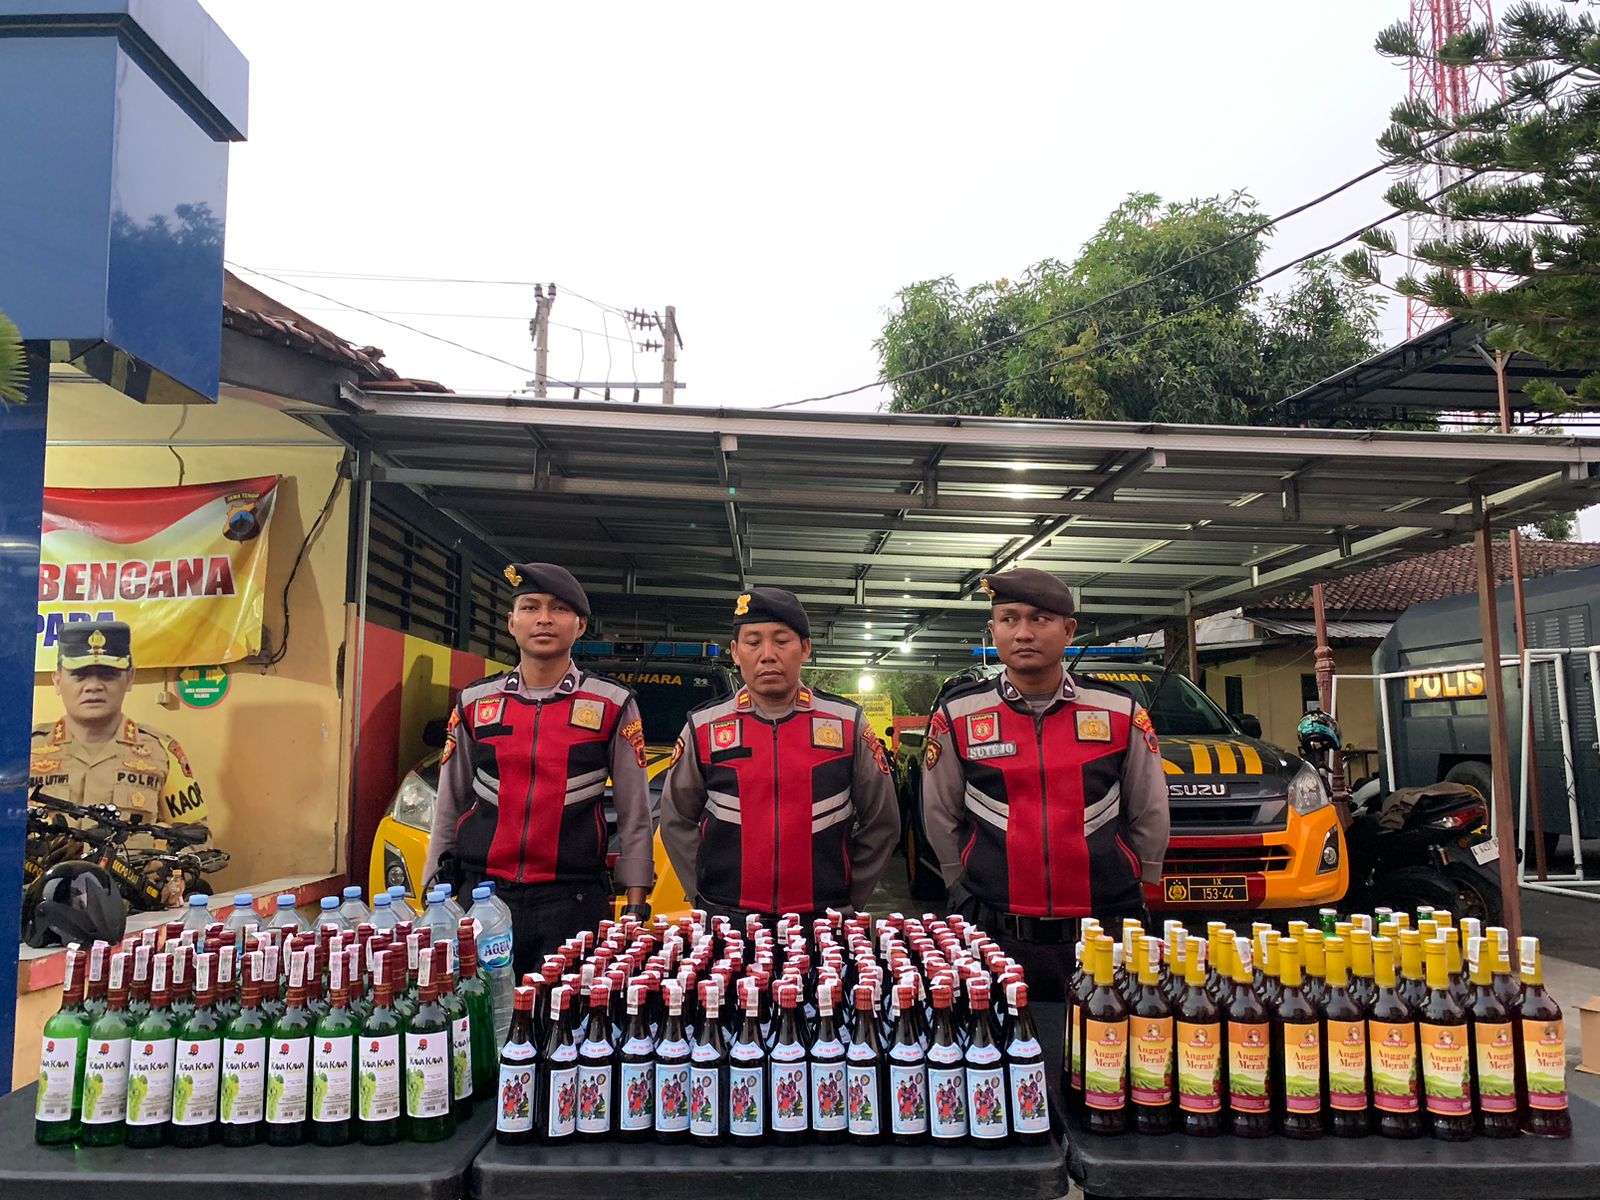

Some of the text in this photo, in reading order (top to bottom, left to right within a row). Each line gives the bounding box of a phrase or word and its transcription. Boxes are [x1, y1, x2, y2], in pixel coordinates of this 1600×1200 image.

[38, 557, 235, 601] BENCANA
[1408, 670, 1485, 699] POLIS
[117, 772, 159, 788] POLRI
[1202, 887, 1234, 900] 153-44
[484, 940, 510, 957] AQUA
[1093, 1049, 1122, 1059] Anggur
[1137, 1044, 1167, 1055] Anggur
[1378, 1049, 1410, 1060] Anggur
[1139, 1054, 1165, 1064] Merah
[1184, 1050, 1215, 1061] Anggur
[1236, 1051, 1266, 1061] Anggur
[1429, 1051, 1463, 1062] Anggur
[1095, 1058, 1121, 1068] Merah
[1186, 1060, 1213, 1070] Merah
[1238, 1060, 1265, 1070] Merah
[1380, 1059, 1409, 1069] Merah
[1431, 1061, 1461, 1072] Merah
